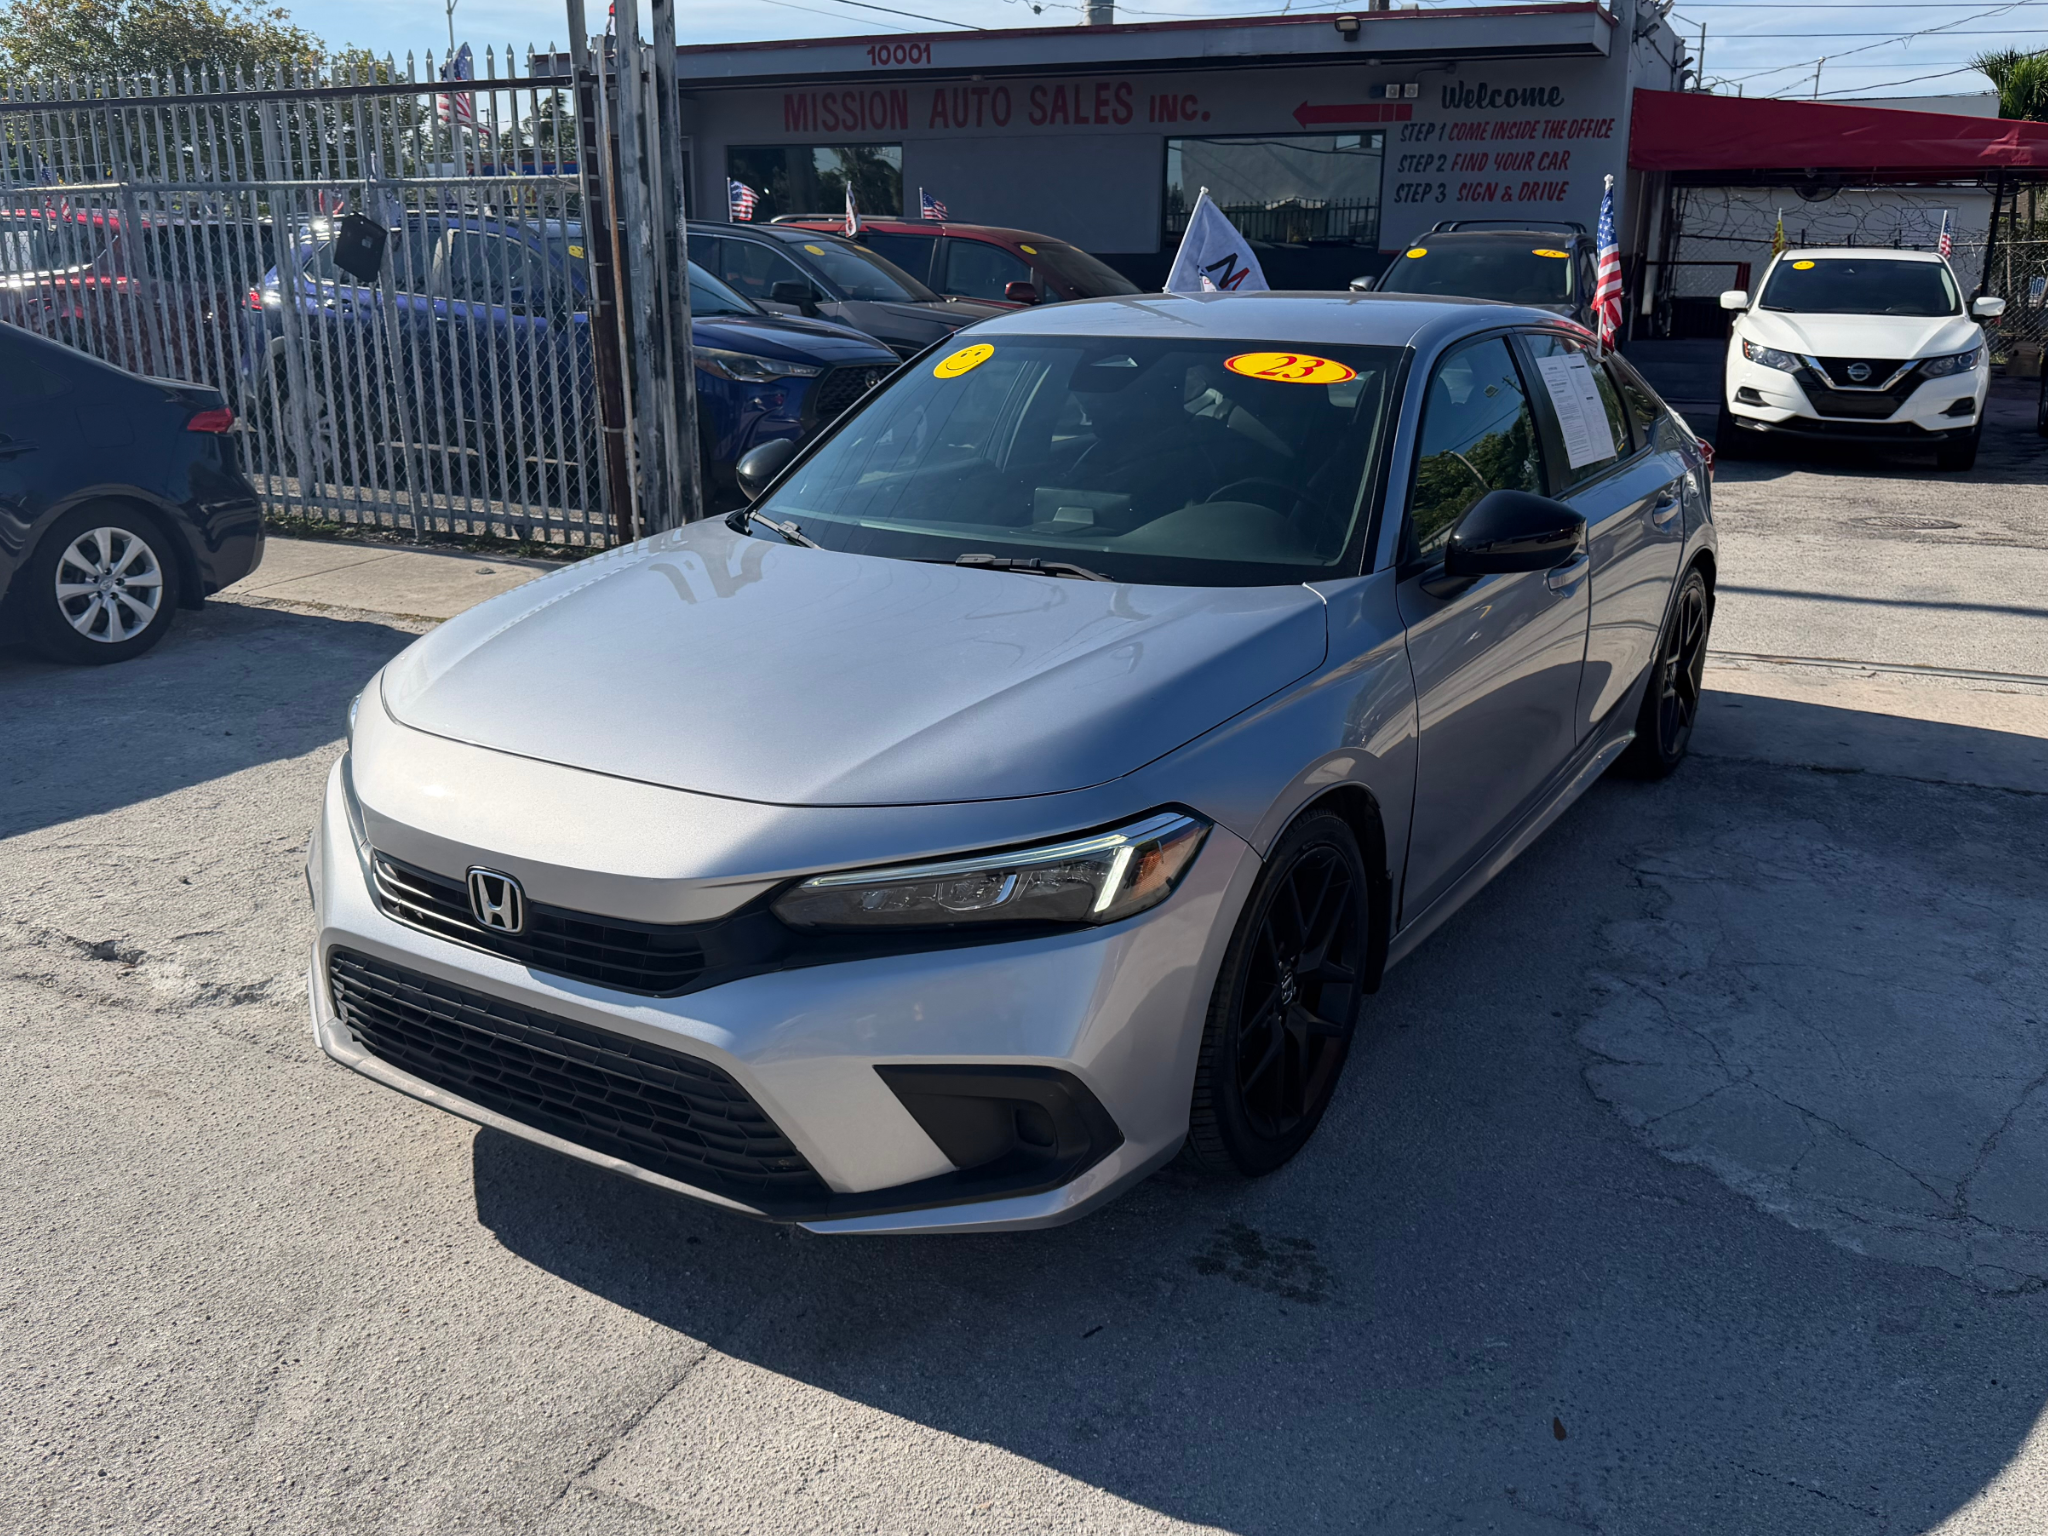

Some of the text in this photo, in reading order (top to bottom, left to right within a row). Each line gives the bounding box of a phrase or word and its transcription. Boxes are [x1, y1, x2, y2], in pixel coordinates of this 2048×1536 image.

[866, 43, 932, 66] 10001
[1441, 80, 1565, 110] Welcome
[783, 81, 1211, 133] MISSION AUTO SALES INC.
[1400, 118, 1615, 142] STEP 1 COME INSIDE THE OFFICE
[1397, 150, 1571, 173] STEP 2 FIND YOUR CAR
[1394, 182, 1433, 203] STEP
[1435, 182, 1447, 203] 3
[1456, 182, 1499, 202] SIGN
[1518, 181, 1569, 202] DRIVE
[1254, 356, 1325, 379] 23
